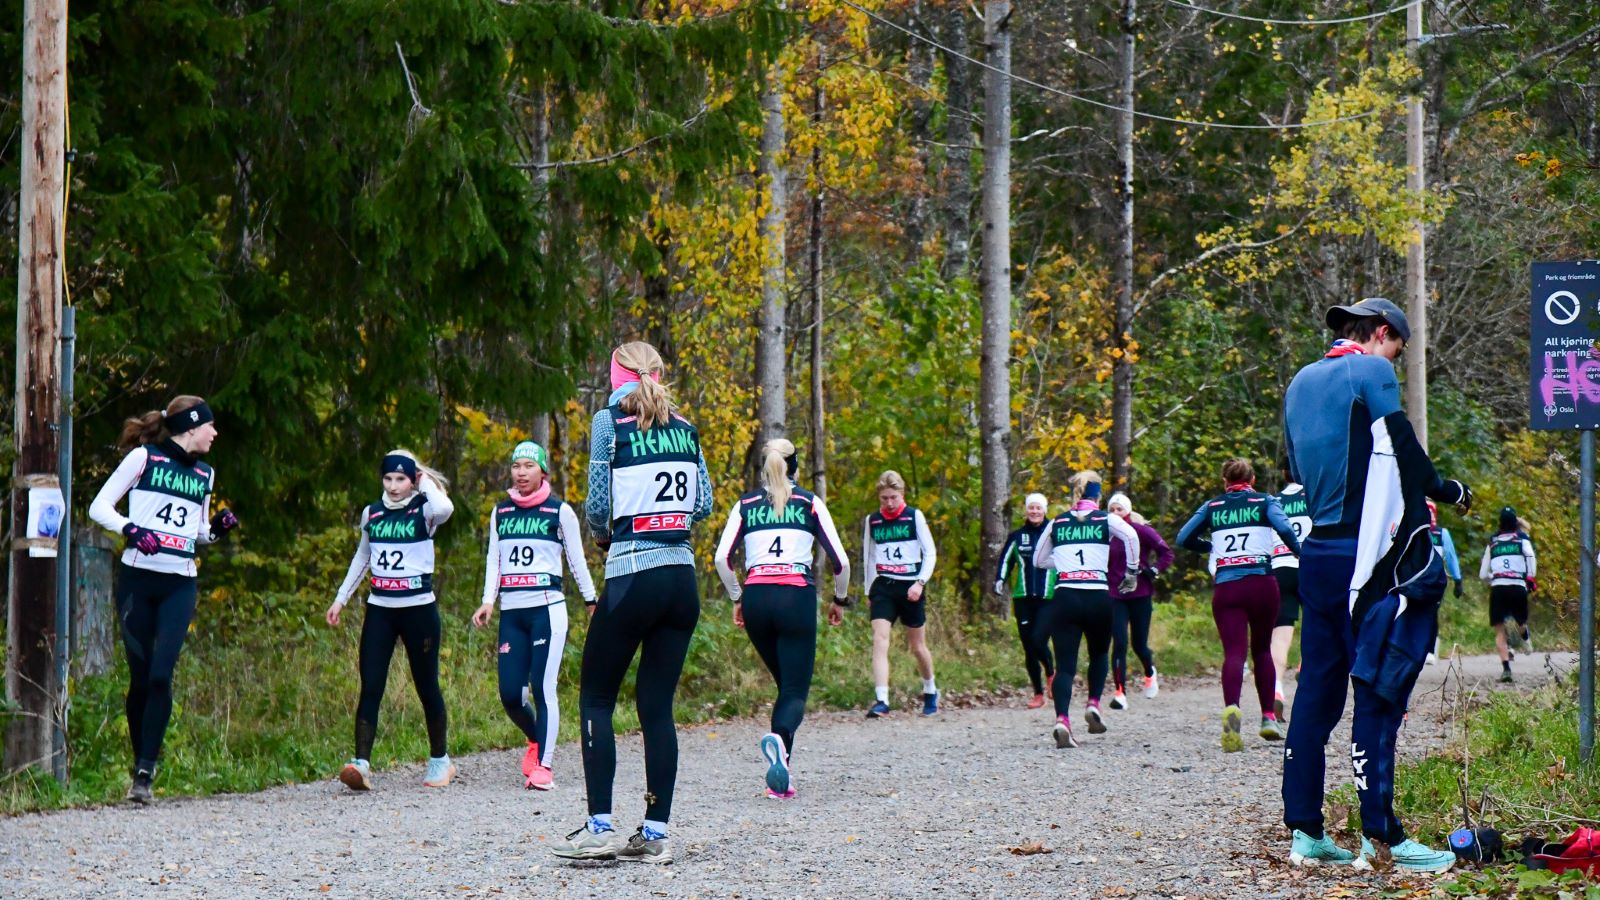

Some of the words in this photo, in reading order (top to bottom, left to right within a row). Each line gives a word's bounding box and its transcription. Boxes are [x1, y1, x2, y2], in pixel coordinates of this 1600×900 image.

[1544, 337, 1559, 346] All
[1560, 337, 1595, 348] kjøring
[1544, 348, 1593, 360] parkring
[629, 428, 697, 457] HEMING
[151, 466, 205, 499] HEMING
[654, 471, 688, 502] 28
[156, 502, 188, 528] 43
[747, 504, 806, 528] HEMING
[1211, 505, 1260, 528] HEMING
[1283, 500, 1307, 515] MIN
[498, 516, 551, 536] HEMING
[873, 524, 910, 541] HEMING
[1057, 524, 1103, 542] HEMING
[156, 533, 185, 550] PAR
[768, 535, 784, 558] 4
[1224, 532, 1250, 553] 27
[376, 549, 405, 571] 42
[508, 545, 534, 567] 49
[883, 546, 903, 561] 14
[1075, 549, 1085, 566] 1
[755, 565, 791, 574] SPAR
[1503, 558, 1510, 569] 8
[375, 579, 409, 589] SPAR
[504, 576, 537, 586] SPAR
[1351, 742, 1369, 791] LYN
